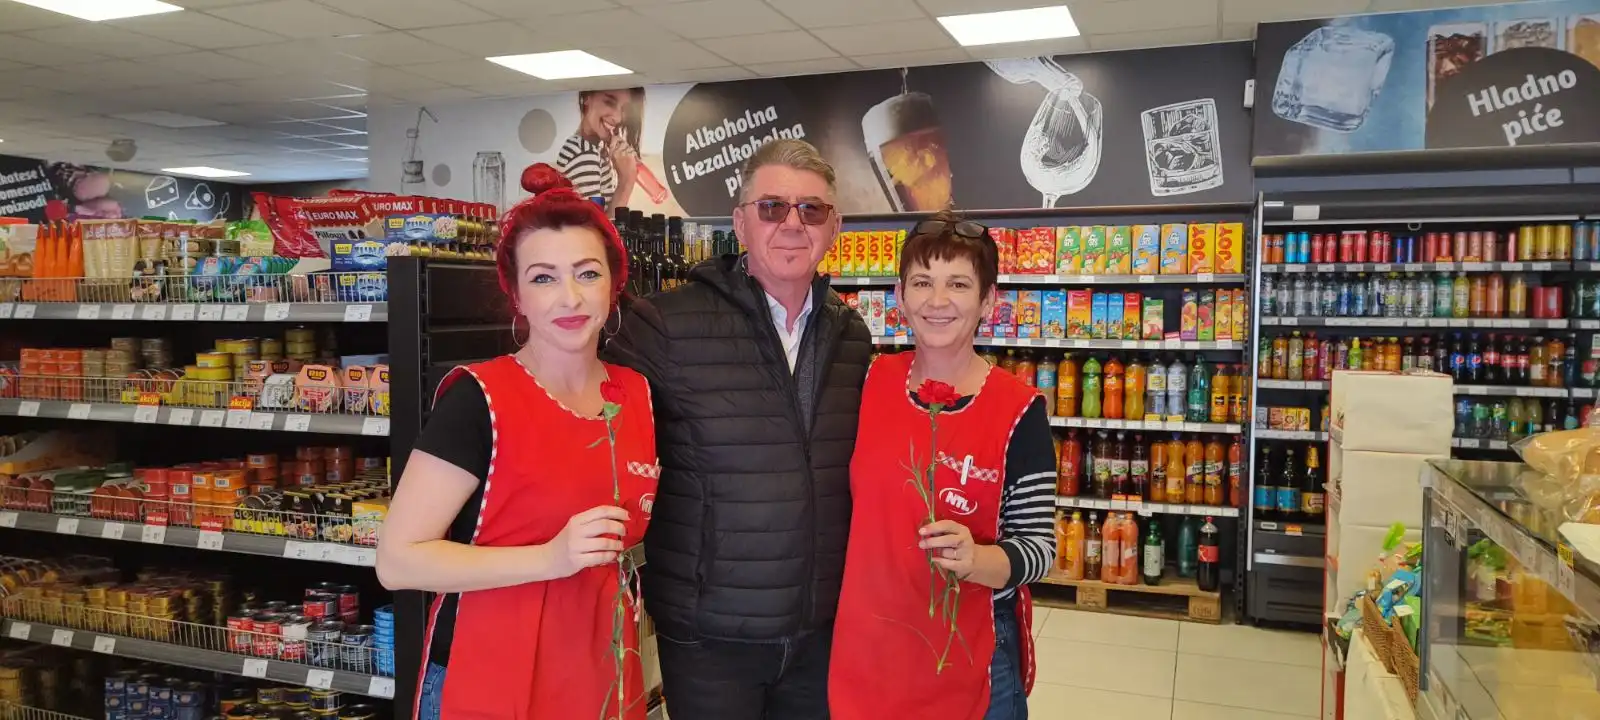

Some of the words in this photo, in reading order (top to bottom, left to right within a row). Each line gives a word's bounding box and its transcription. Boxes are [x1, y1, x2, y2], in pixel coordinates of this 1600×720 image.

[1467, 69, 1577, 117] Hladno
[686, 105, 778, 154] Alkoholna
[1502, 103, 1564, 147] piće
[671, 166, 681, 184] i
[312, 212, 336, 220] EURO
[336, 211, 360, 220] MAX
[392, 201, 414, 211] MAX
[841, 235, 852, 261] JOY
[855, 235, 865, 261] JOY
[869, 235, 879, 261] JOY
[883, 235, 894, 261] JOY
[1191, 226, 1206, 261] JOY
[1217, 226, 1233, 261] JOY
[308, 369, 326, 378] RIO
[945, 491, 970, 512] NTL
